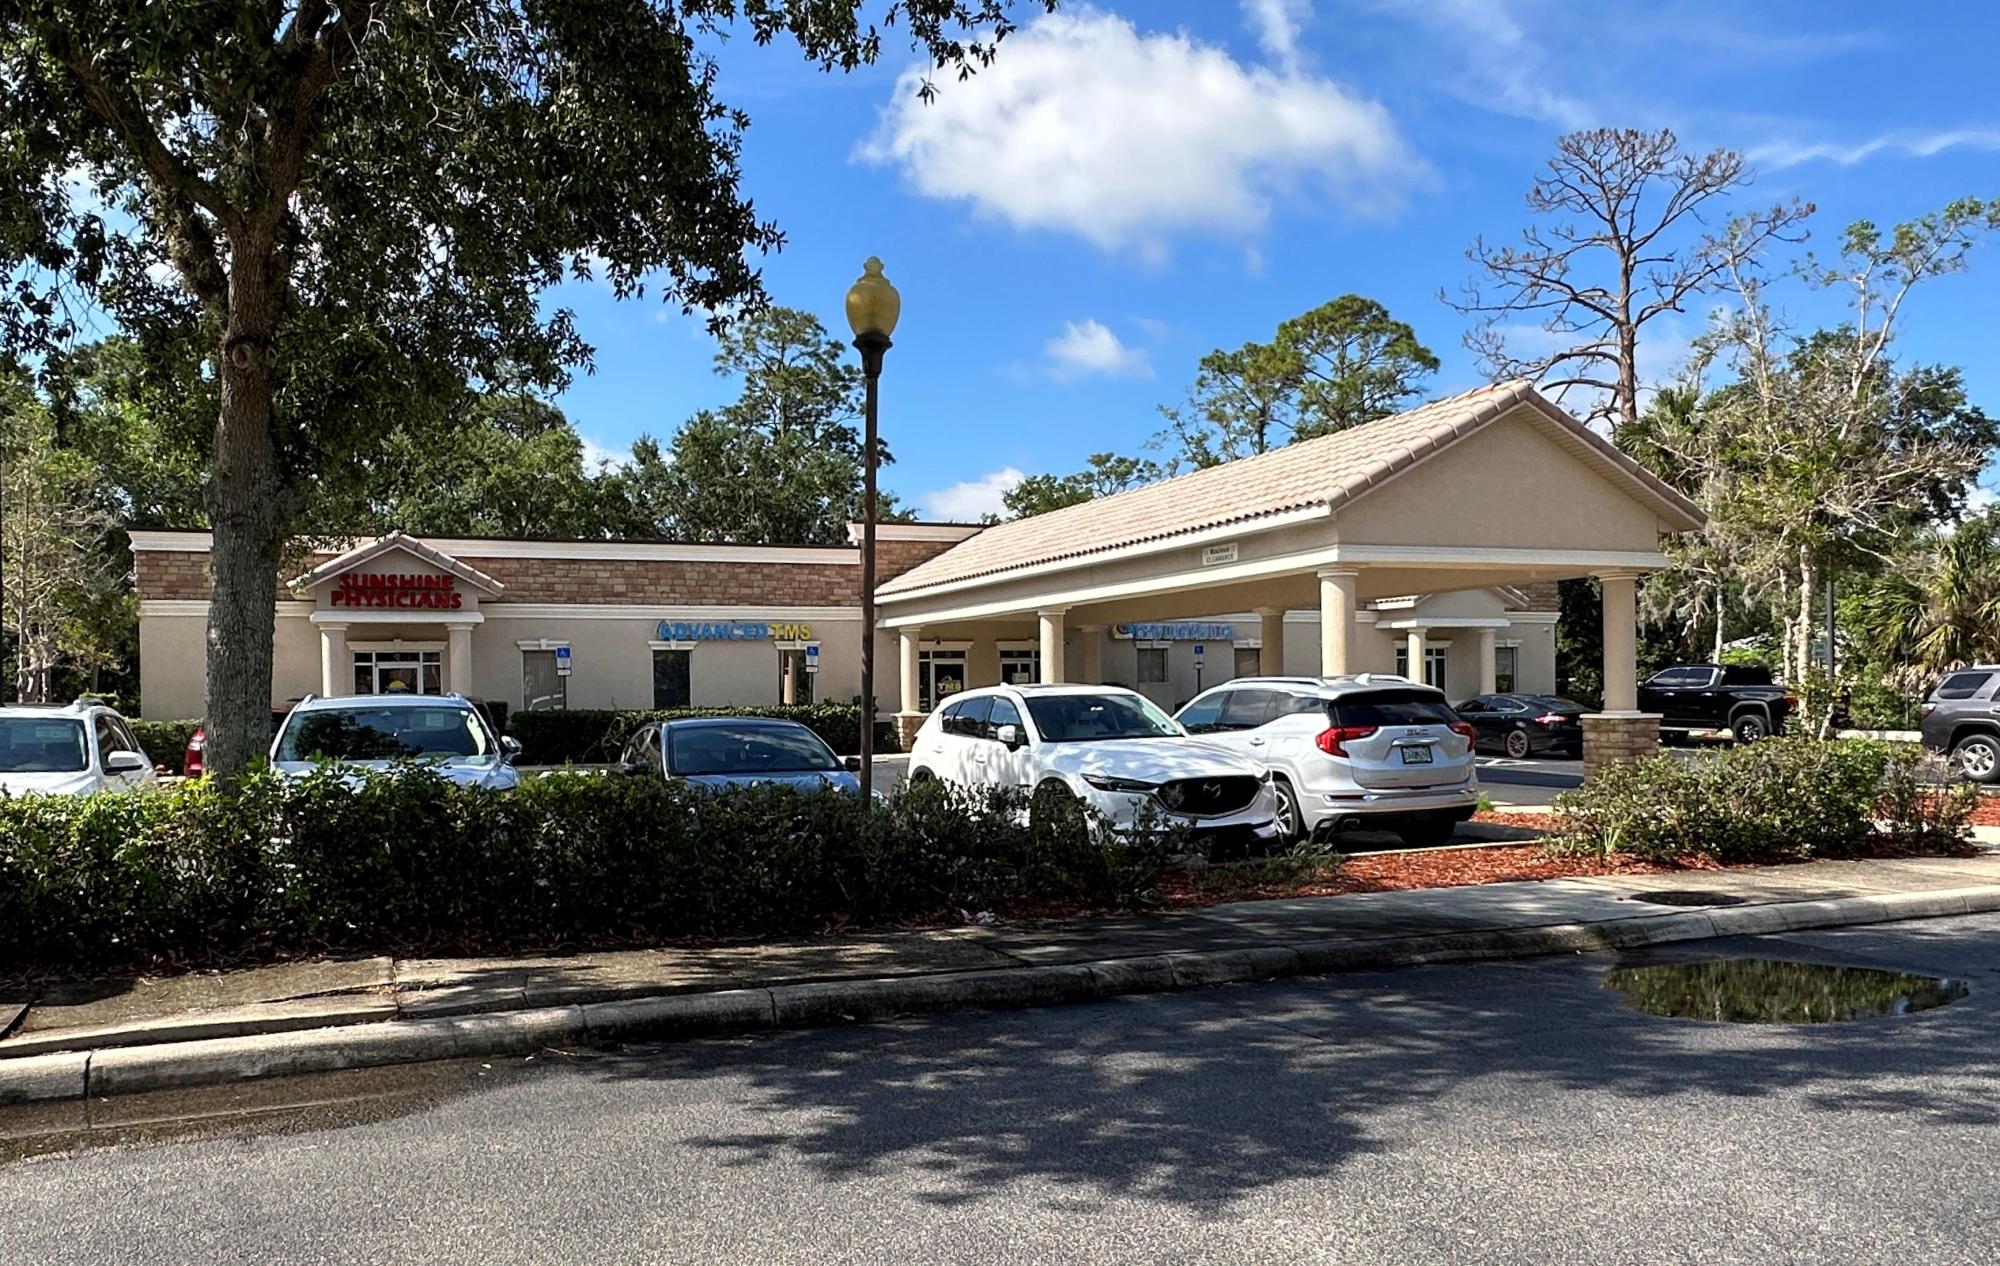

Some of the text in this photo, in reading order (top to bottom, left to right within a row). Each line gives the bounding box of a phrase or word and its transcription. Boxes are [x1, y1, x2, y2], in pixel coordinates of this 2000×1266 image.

[339, 573, 455, 591] SUNSHINE
[331, 590, 462, 609] PHYSICIANS
[658, 621, 812, 641] ADVANCED TMS
